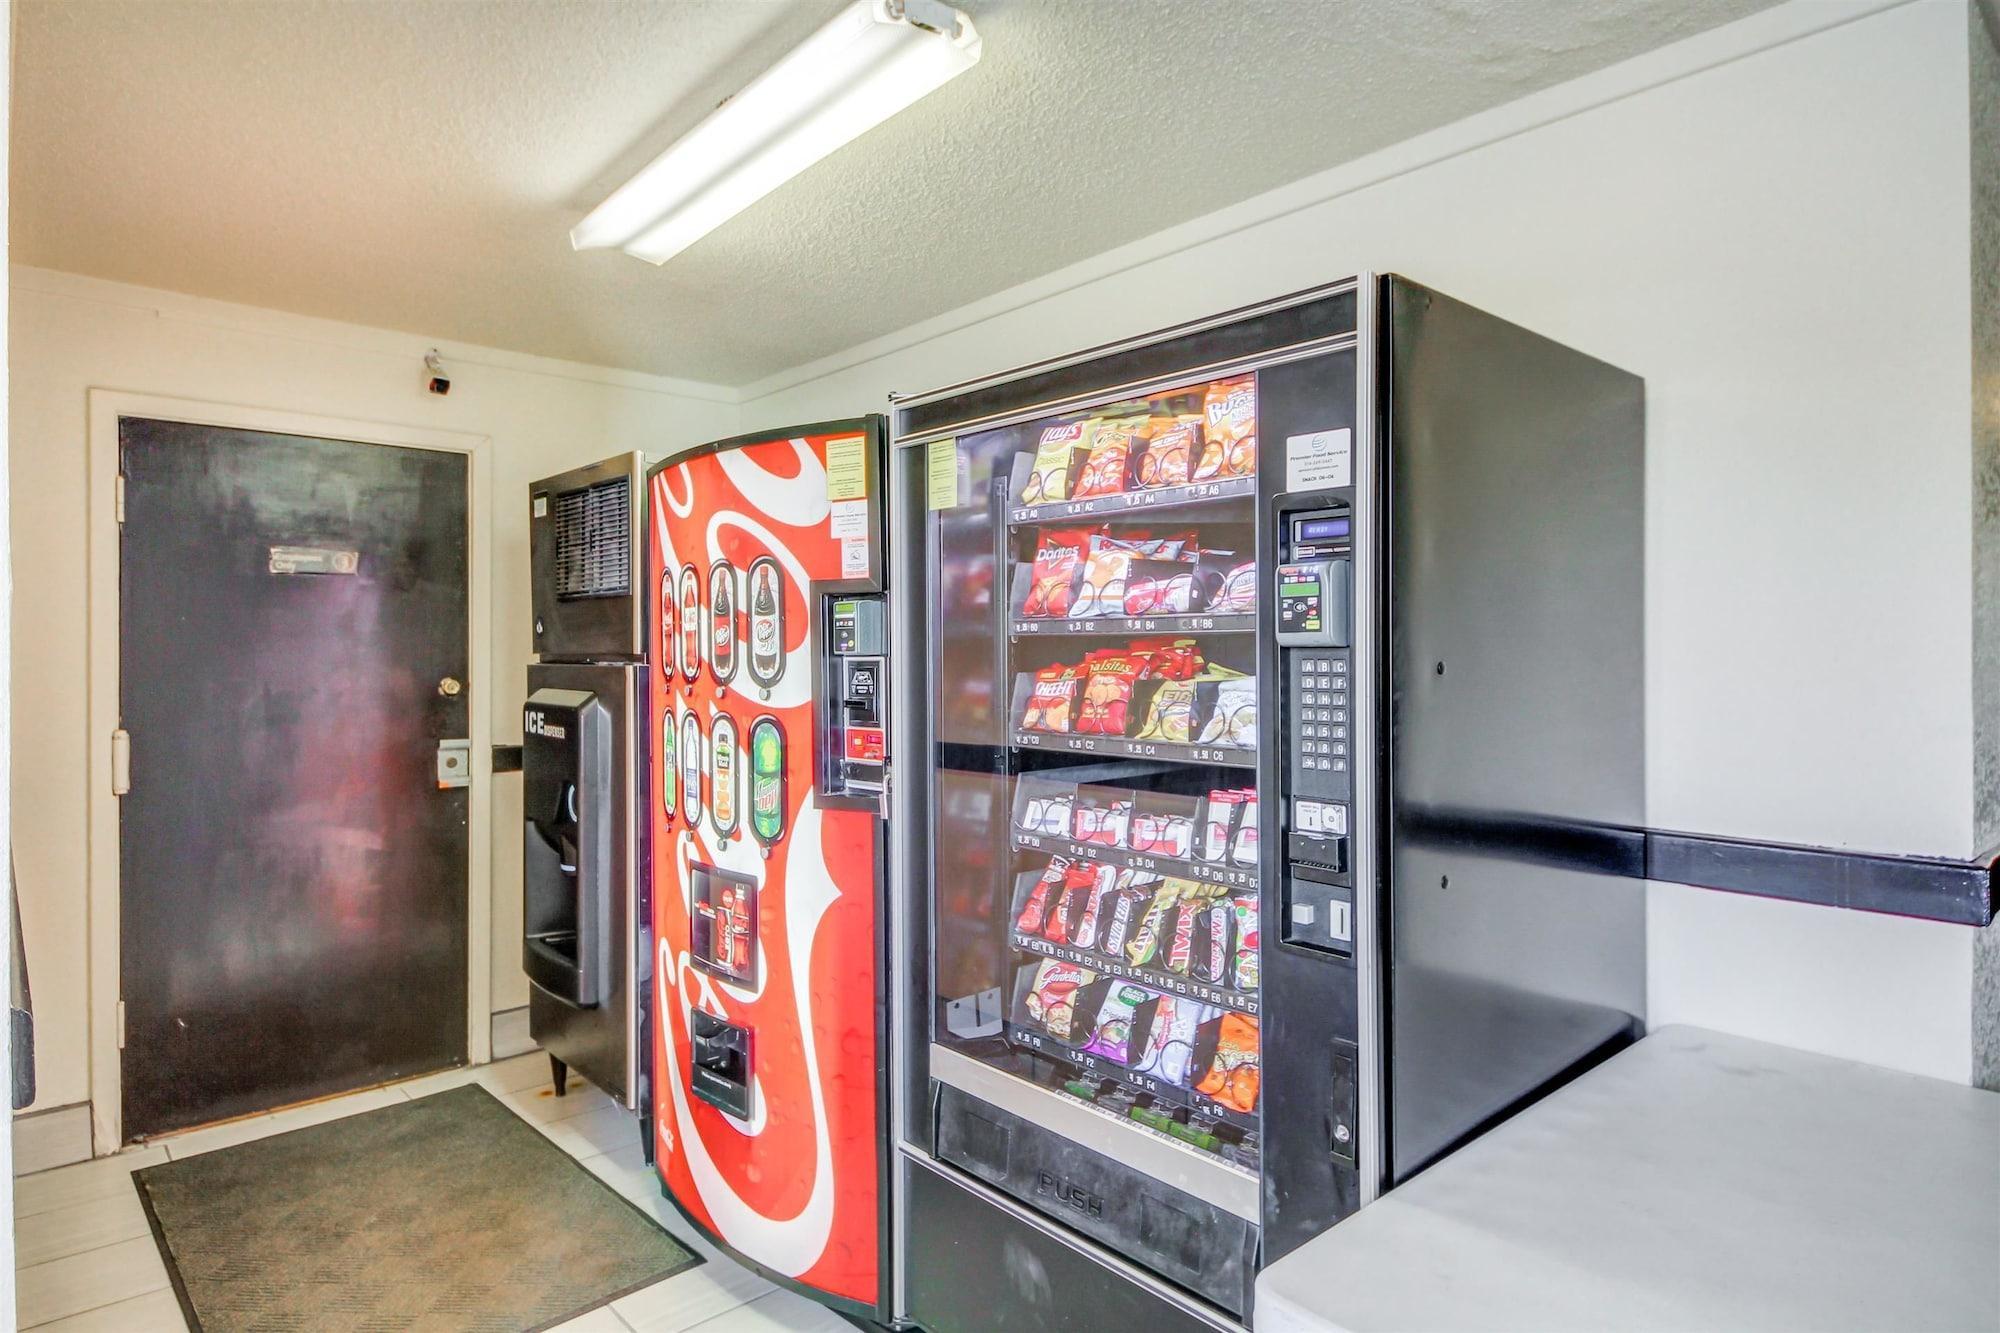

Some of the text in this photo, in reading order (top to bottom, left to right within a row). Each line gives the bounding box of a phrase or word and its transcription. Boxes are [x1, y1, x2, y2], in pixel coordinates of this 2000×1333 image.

[1208, 485, 1219, 495] A6
[1145, 494, 1155, 503] A4
[1085, 502, 1094, 511] A2
[1036, 546, 1080, 562] Doritos
[1085, 622, 1094, 631] B2
[1146, 620, 1155, 630] B4
[1203, 619, 1213, 628] B6
[1306, 663, 1312, 672] A
[1322, 663, 1327, 672] B
[1338, 663, 1344, 672] C
[1306, 679, 1312, 688] D
[1322, 679, 1328, 688] E
[1338, 679, 1343, 688] F
[1306, 695, 1312, 704] G
[1322, 695, 1328, 704] H
[1307, 711, 1312, 720] 1
[1322, 712, 1328, 720] 2
[1338, 712, 1343, 721] 3
[525, 711, 544, 734] ICE
[1307, 726, 1312, 736] 4
[1322, 727, 1328, 736] 5
[1338, 728, 1343, 738] 6
[1085, 740, 1094, 750] C2
[1146, 745, 1155, 755] C4
[1307, 743, 1312, 752] 7
[1322, 744, 1328, 753] 8
[1338, 745, 1343, 754] 9
[1213, 751, 1223, 761] C6
[1087, 849, 1096, 858] D2
[1145, 859, 1155, 869] D4
[1213, 872, 1223, 882] D6
[1168, 904, 1195, 969] TWIX
[1057, 949, 1064, 958] E1
[1084, 956, 1093, 966] E2
[1113, 964, 1122, 975] E3
[1144, 973, 1153, 984] E4
[1177, 982, 1186, 994] E5
[1211, 992, 1221, 1003] E6
[1248, 1002, 1258, 1013] E7
[1033, 1037, 1041, 1047] F0
[1086, 1058, 1095, 1068] F2
[1147, 1080, 1155, 1090] F4
[1214, 1104, 1223, 1116] F6
[1036, 1169, 1104, 1221] PUSH
